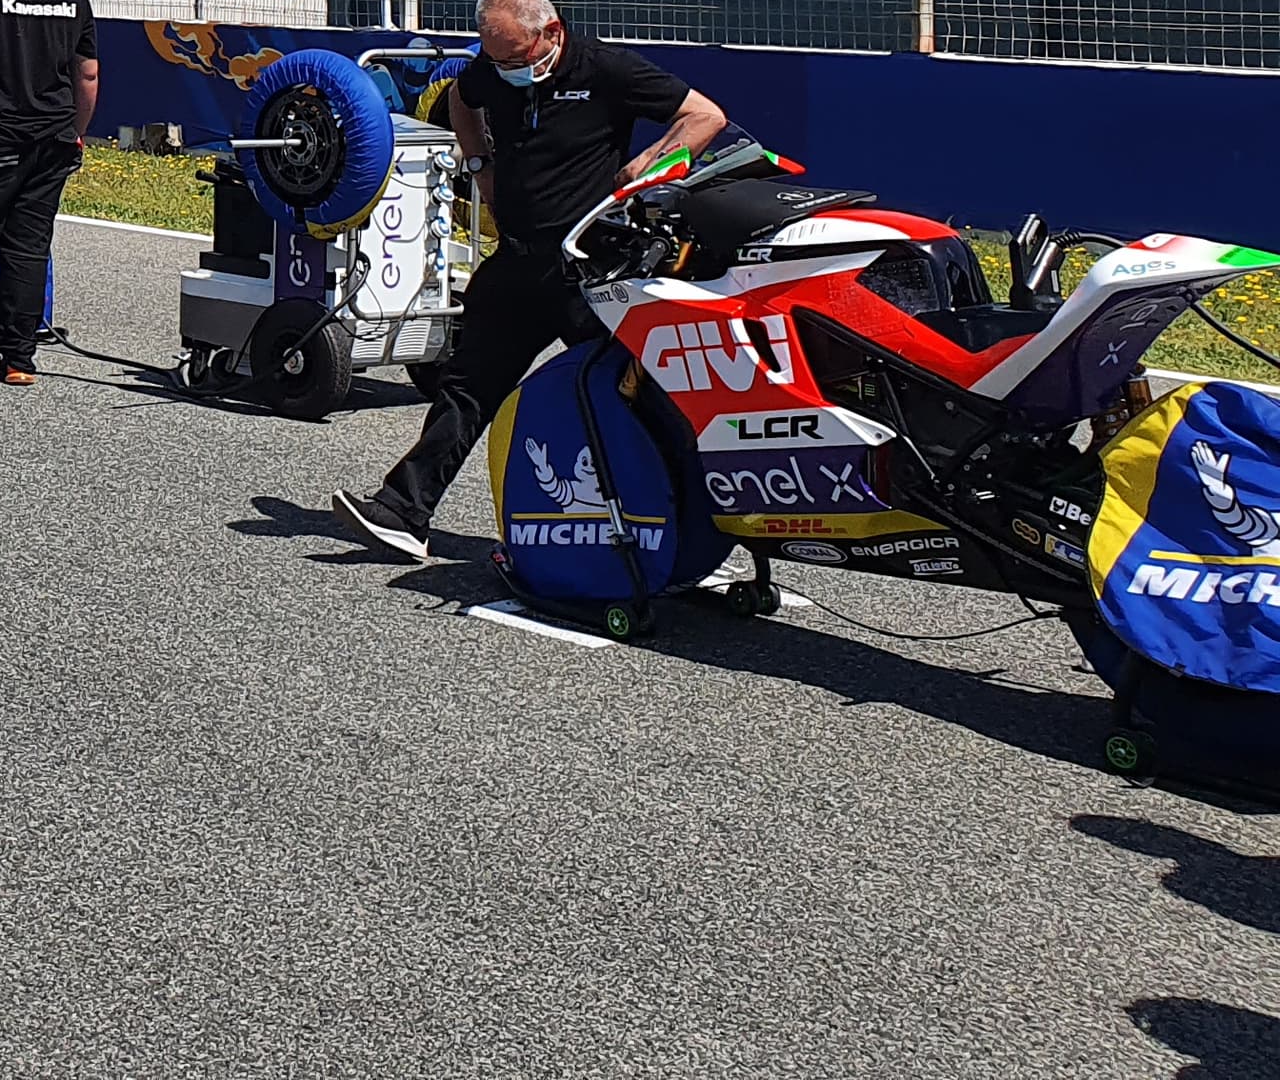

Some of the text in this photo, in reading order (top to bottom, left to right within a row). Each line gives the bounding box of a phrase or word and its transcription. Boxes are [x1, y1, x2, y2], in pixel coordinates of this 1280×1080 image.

[553, 90, 591, 101] LCR
[381, 192, 403, 289] enel
[737, 247, 773, 263] LCR
[641, 313, 795, 392] GIVI
[739, 414, 825, 440] LCR
[705, 456, 816, 508] enel
[510, 523, 664, 552] MICHEN
[763, 518, 833, 534] DHL
